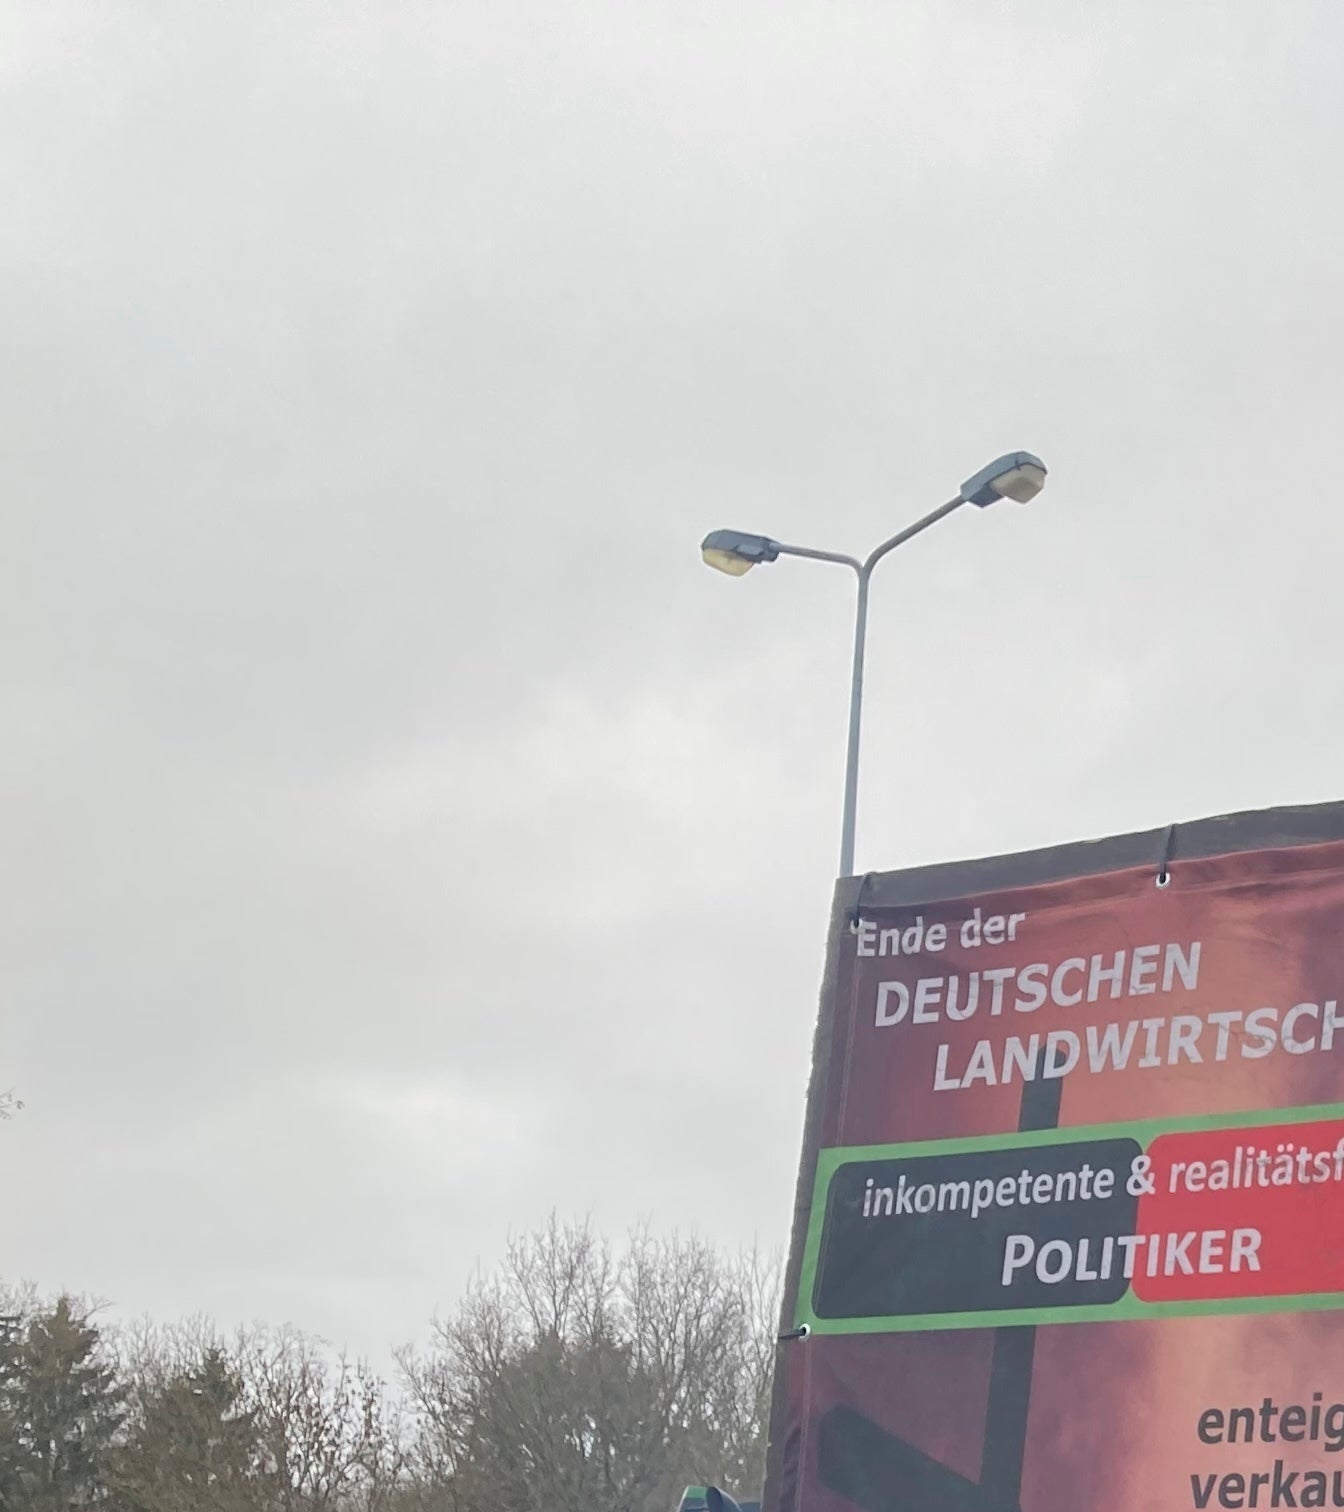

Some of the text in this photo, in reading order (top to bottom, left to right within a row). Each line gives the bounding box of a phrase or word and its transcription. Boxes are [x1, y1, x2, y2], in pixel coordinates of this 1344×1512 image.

[857, 909, 1026, 958] Ende der
[874, 942, 1201, 1028] DEUTSCHEN
[862, 1161, 1115, 1218] inkompetente
[1127, 1155, 1157, 1196] &
[1001, 1227, 1263, 1287] POLITIKER
